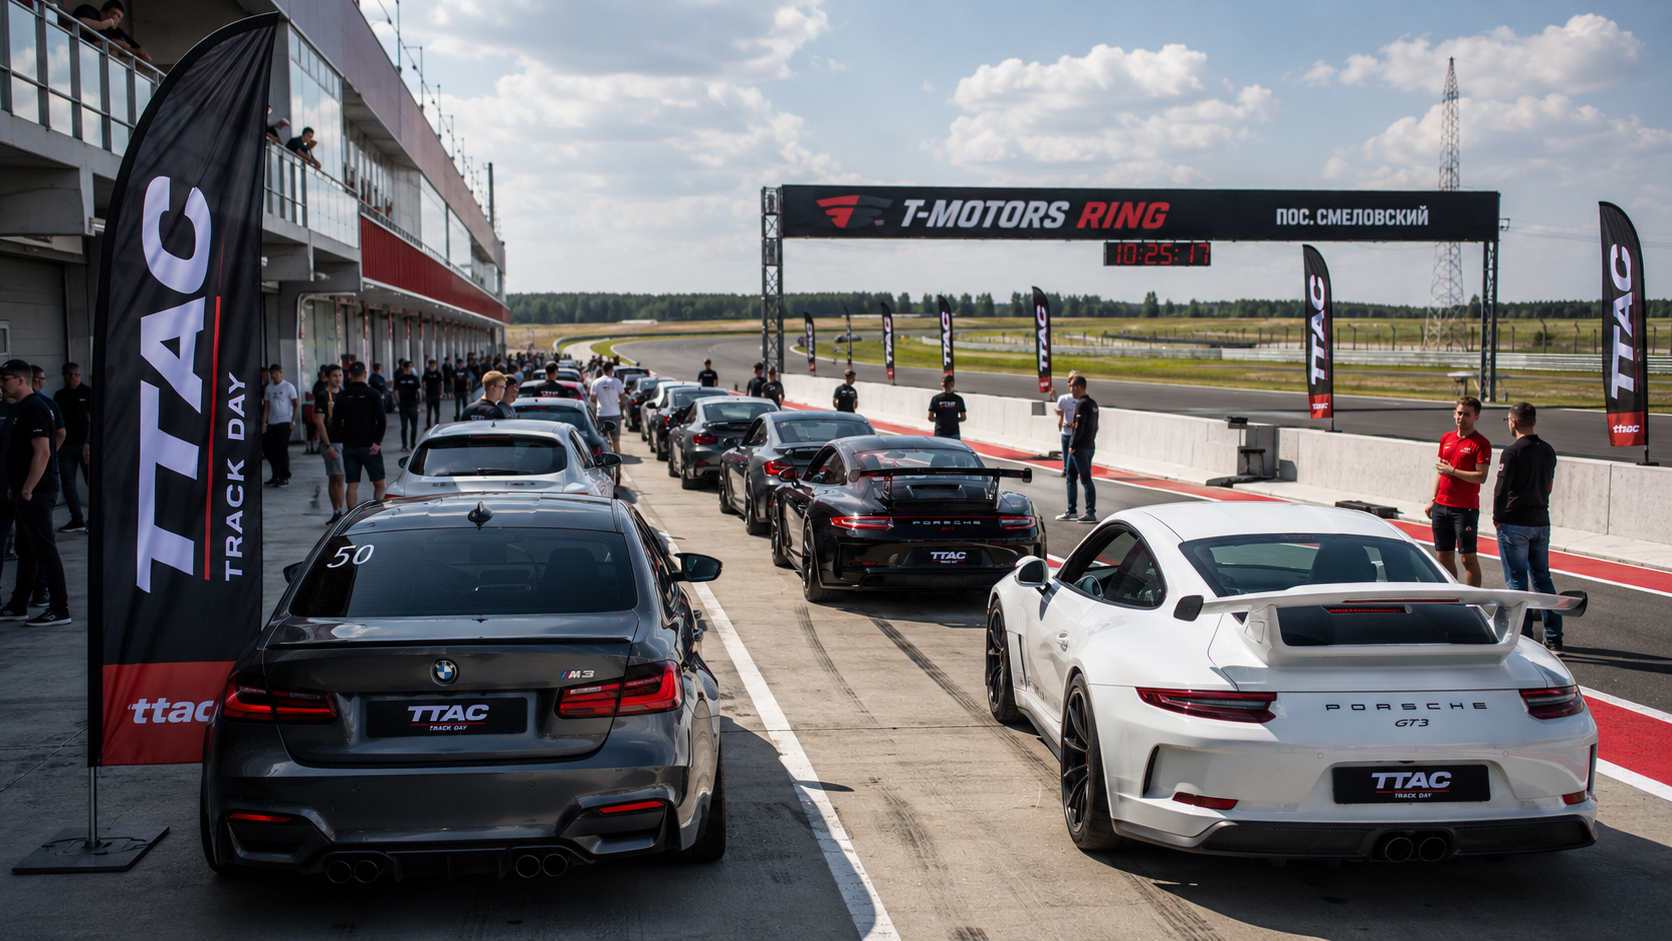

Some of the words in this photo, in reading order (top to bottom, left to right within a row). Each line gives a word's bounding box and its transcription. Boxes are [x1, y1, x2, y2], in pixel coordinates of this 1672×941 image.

[900, 198, 1071, 229] T-MOTORS
[1076, 201, 1170, 230] RING
[1276, 208, 1314, 225] ПОС.
[1316, 205, 1429, 226] СМЕЛОВСКИЙ
[1116, 243, 1210, 265] 10:25:17
[1309, 274, 1325, 386] TTAC
[1610, 243, 1634, 400] TTAC
[942, 311, 951, 366] TTAC
[1036, 304, 1049, 372] TTAC
[137, 175, 212, 594] TTAC
[227, 371, 246, 441] DAY
[225, 458, 245, 582] TRACK
[326, 536, 375, 568] 50
[930, 551, 967, 560] TTAC
[407, 704, 490, 722] TTAC
[1325, 702, 1488, 711] PORSCHE
[1394, 718, 1430, 728] GT3
[1371, 771, 1452, 789] TTAC
